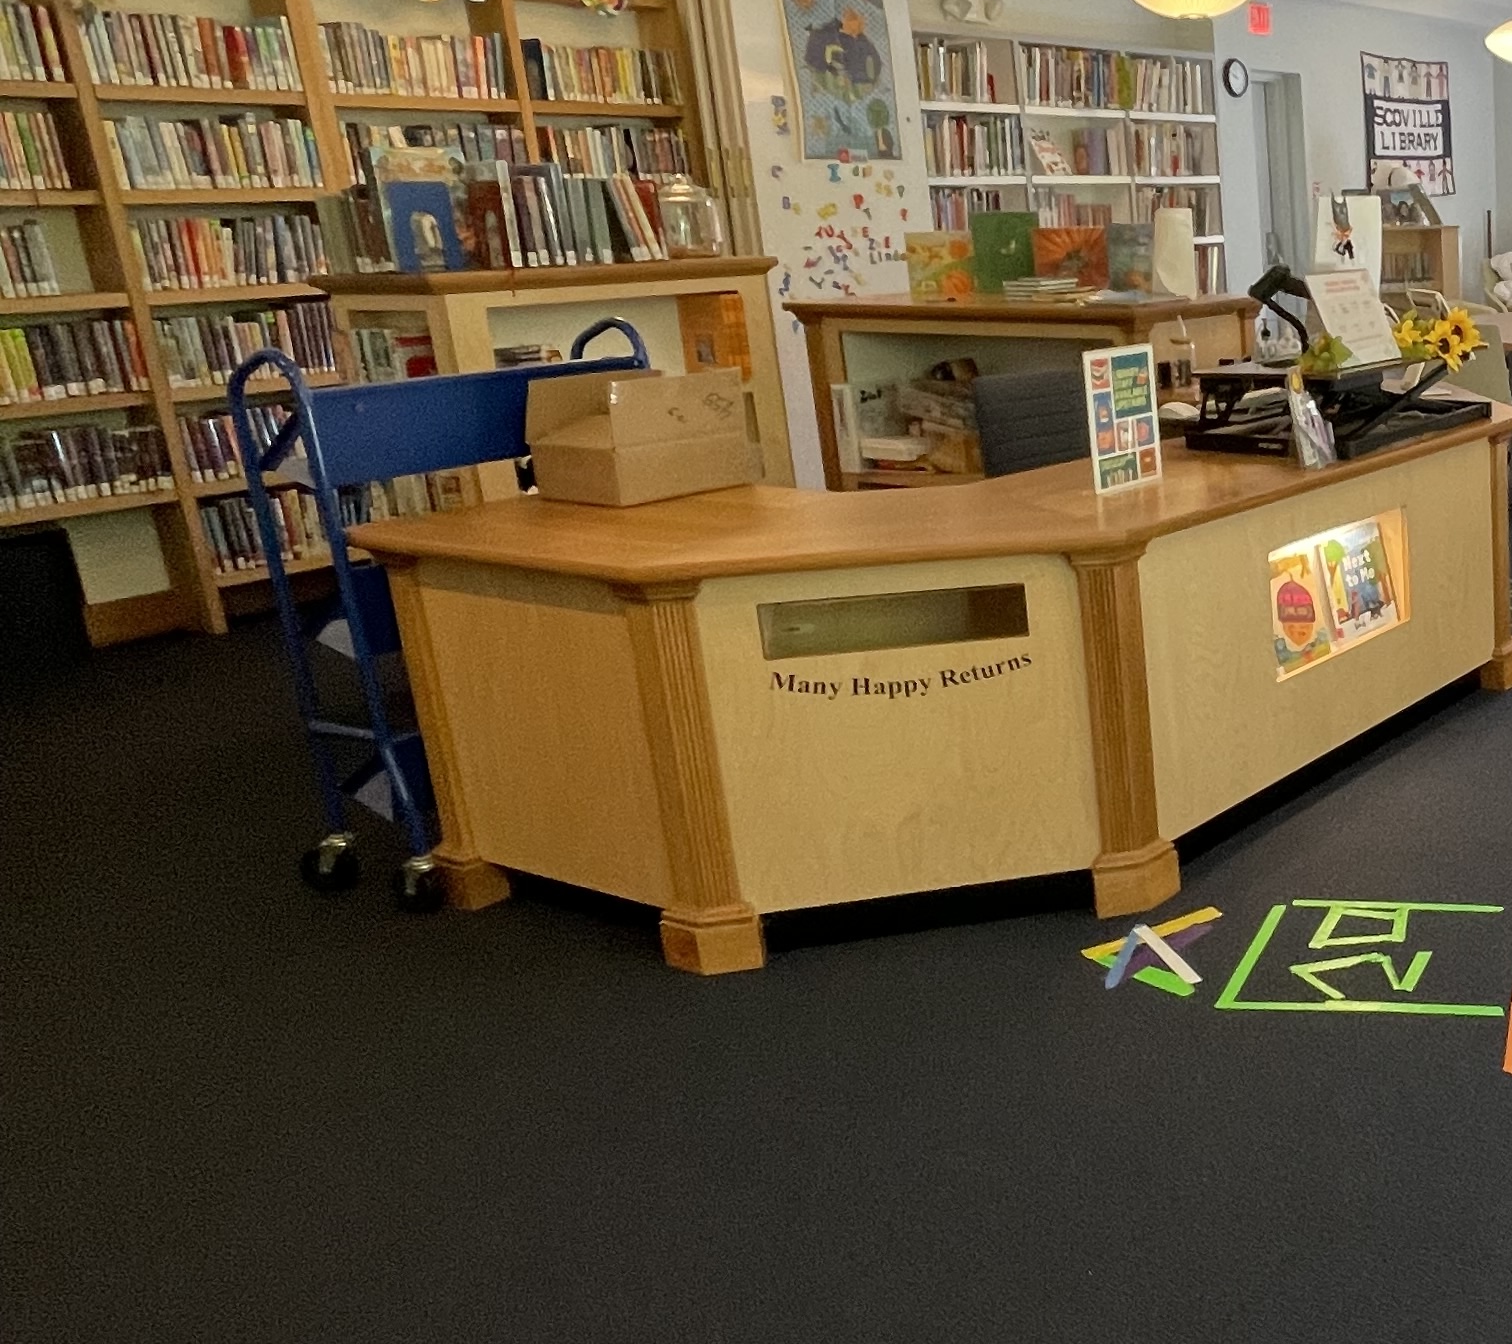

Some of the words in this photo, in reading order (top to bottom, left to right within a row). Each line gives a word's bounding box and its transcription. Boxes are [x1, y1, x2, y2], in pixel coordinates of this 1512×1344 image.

[1380, 131, 1439, 151] LIBRARY
[1342, 549, 1372, 572] Next
[1345, 574, 1359, 587] to
[769, 671, 844, 701] Many
[851, 676, 931, 700] Happy
[938, 652, 1033, 688] Returns
